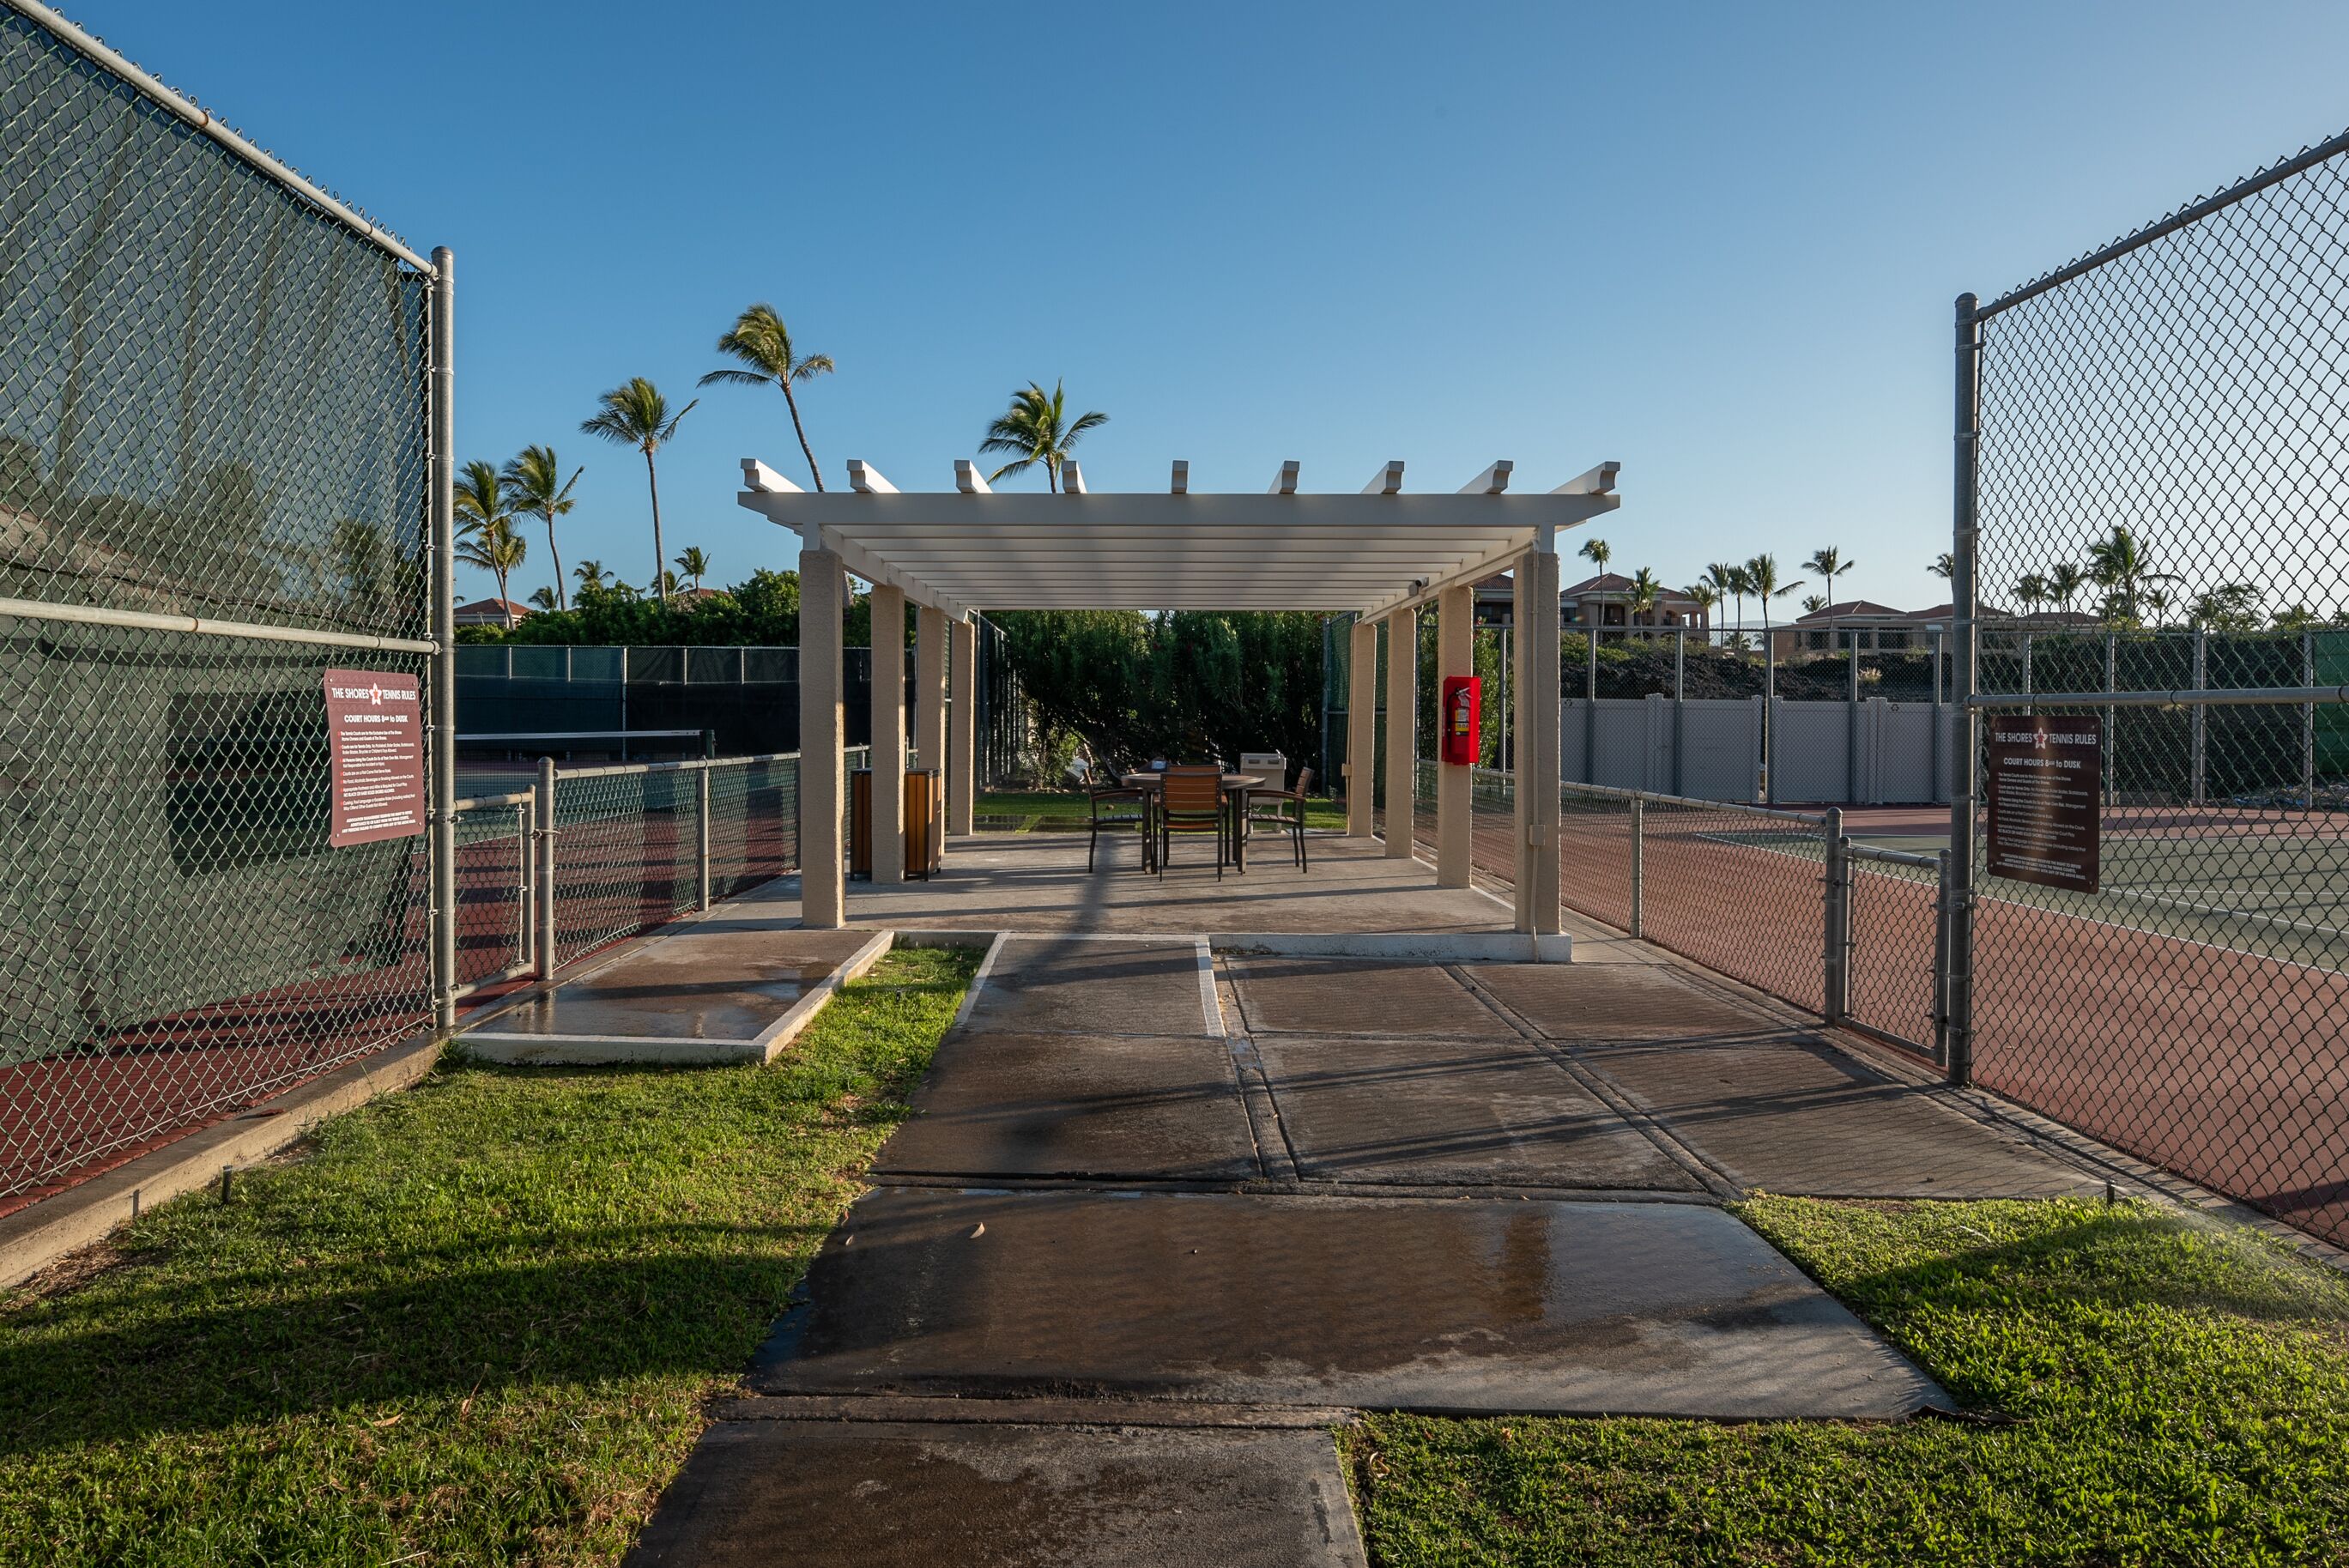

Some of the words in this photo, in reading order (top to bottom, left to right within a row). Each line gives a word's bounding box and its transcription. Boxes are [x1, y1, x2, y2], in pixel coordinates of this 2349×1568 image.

[332, 687, 344, 698] THE
[345, 688, 369, 699] SHORES
[382, 689, 400, 699] TENNIS
[401, 690, 416, 700] RULES
[1995, 732, 2006, 742] THE
[2007, 733, 2033, 743] SHORES
[2049, 734, 2073, 744] TENNIS
[2074, 734, 2097, 745] RULES
[2004, 757, 2022, 766] COURT
[2024, 758, 2043, 766] HOURS
[2063, 760, 2081, 769] DUSK
